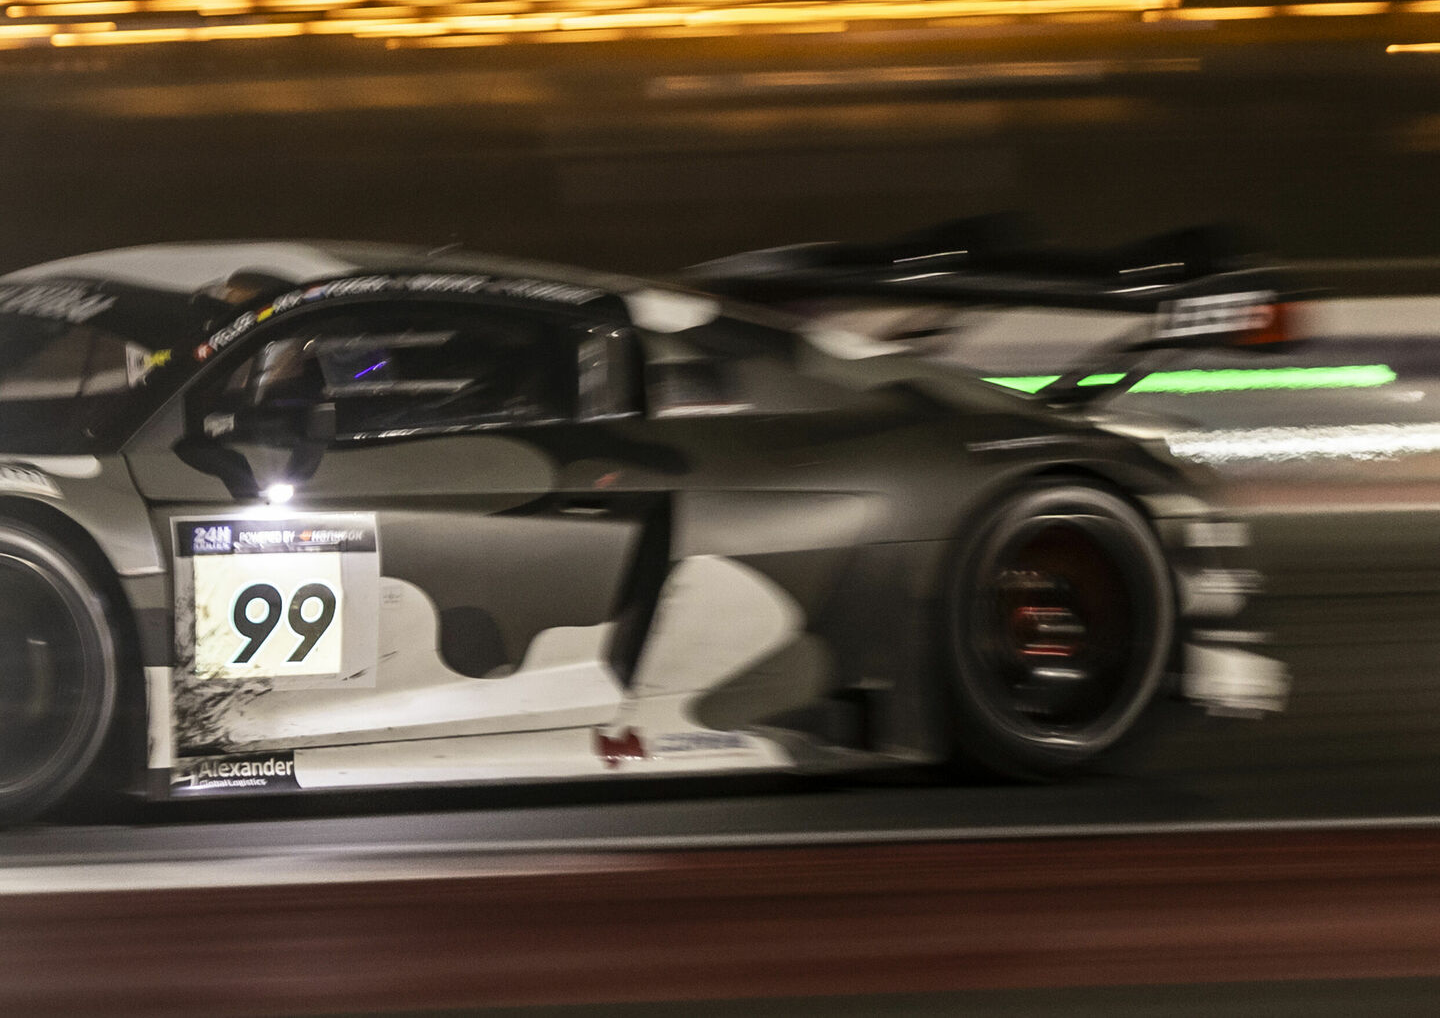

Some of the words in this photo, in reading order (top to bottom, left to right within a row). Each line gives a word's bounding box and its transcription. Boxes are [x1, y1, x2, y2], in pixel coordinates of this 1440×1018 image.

[283, 530, 296, 543] BY
[233, 583, 336, 663] 99
[198, 758, 294, 778] Alexander
[227, 778, 268, 787] Logistics
